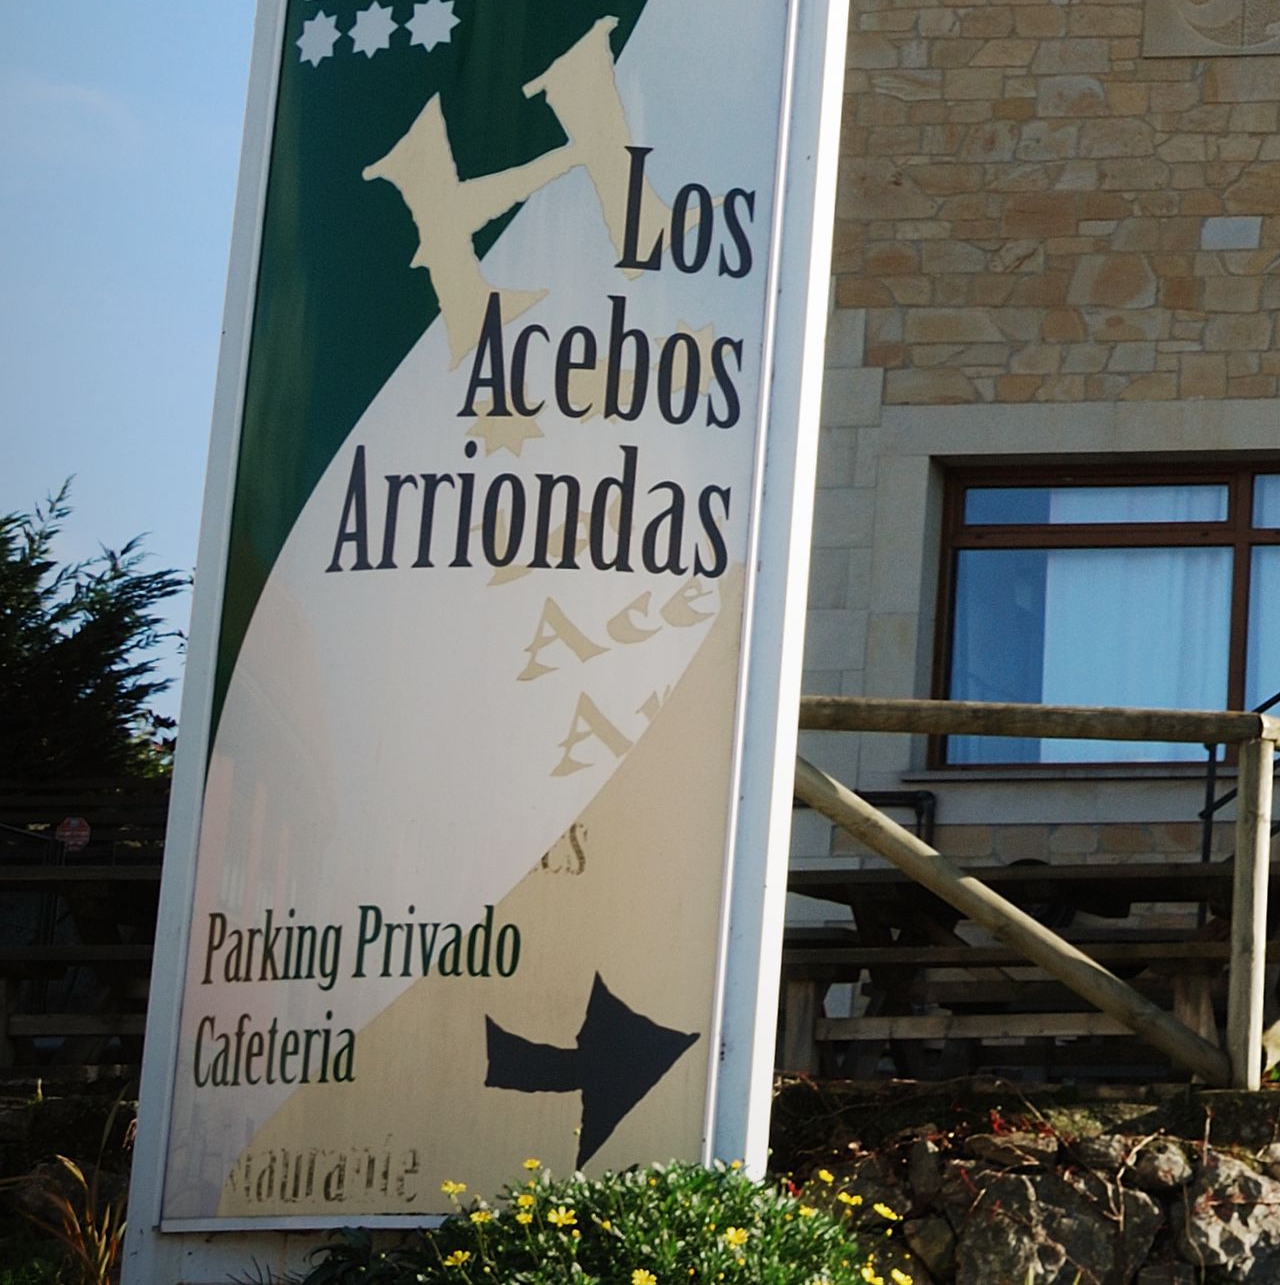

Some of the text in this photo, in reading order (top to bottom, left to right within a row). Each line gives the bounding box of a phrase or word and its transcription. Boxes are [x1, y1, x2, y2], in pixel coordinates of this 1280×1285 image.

[614, 146, 756, 278] Los
[457, 292, 743, 428] Acebos
[325, 440, 731, 578] Arriondas
[201, 905, 521, 991] Parking Privado
[194, 1010, 356, 1088] Cafeteria
